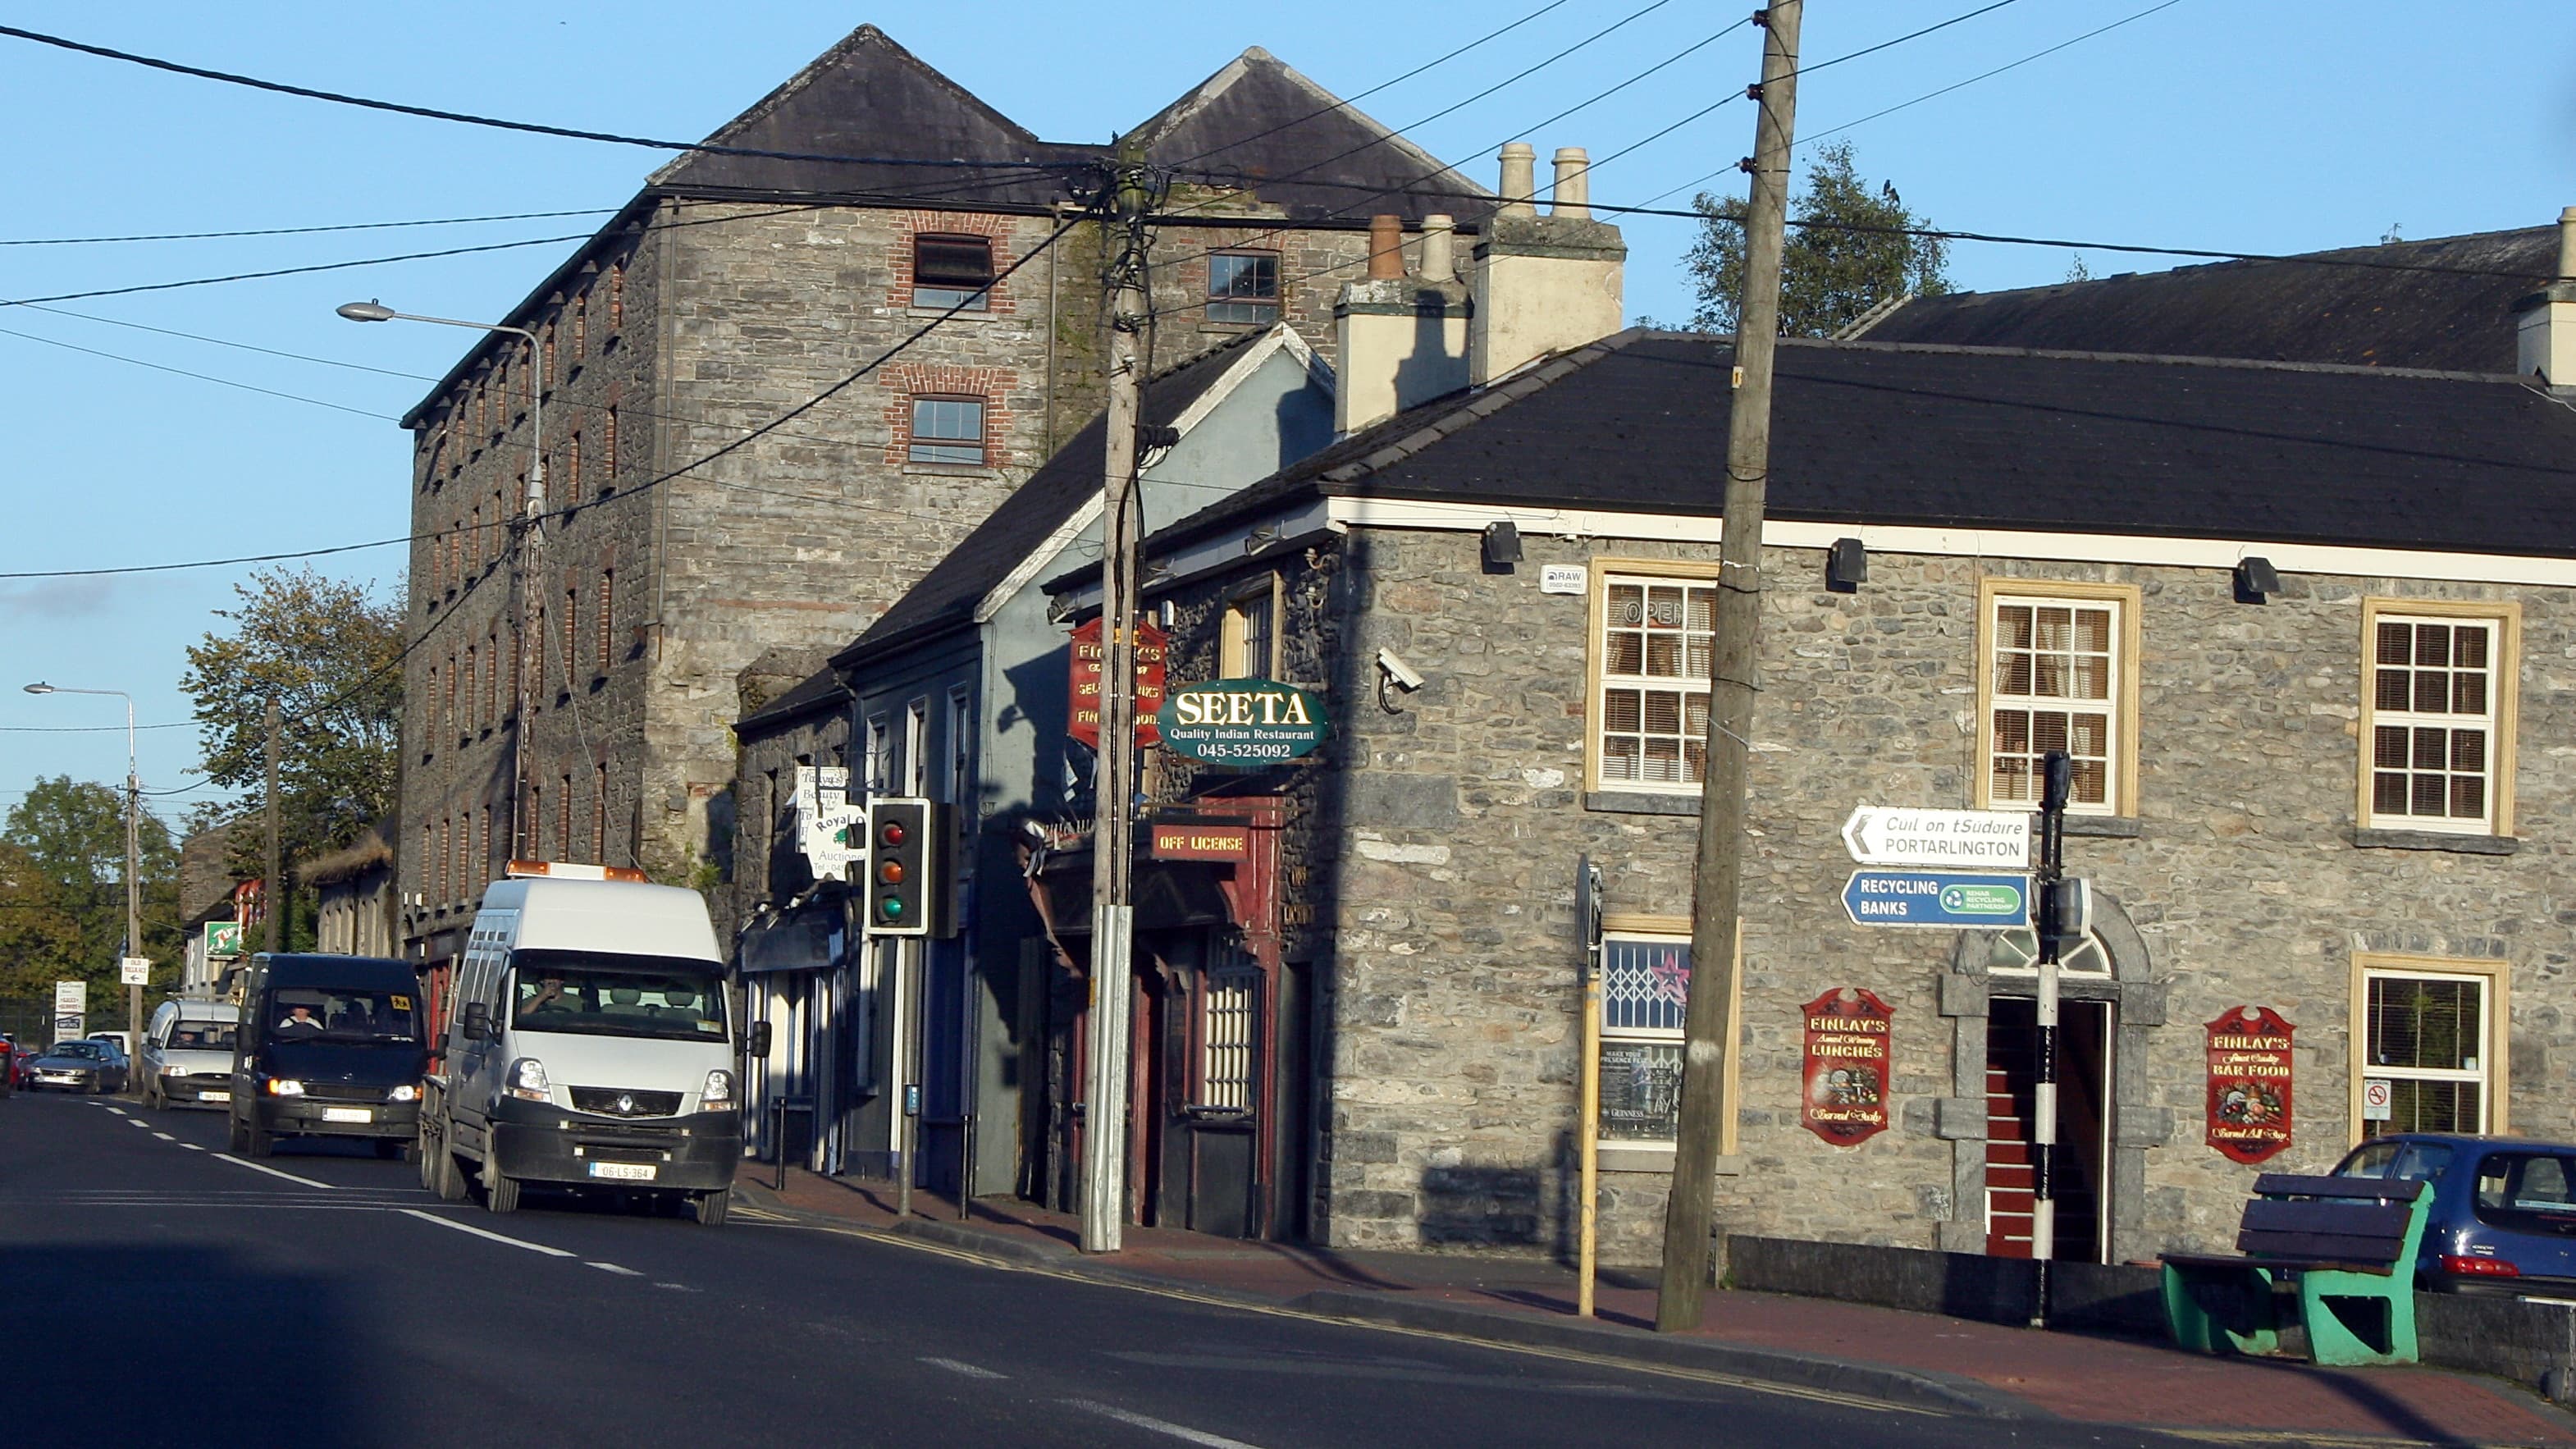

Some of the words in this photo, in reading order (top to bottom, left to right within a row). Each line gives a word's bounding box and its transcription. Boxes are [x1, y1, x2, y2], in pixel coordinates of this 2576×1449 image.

[1176, 692, 1313, 726] SEETA
[1170, 728, 1211, 741] Quality
[1215, 728, 1250, 739] Indian
[1254, 729, 1314, 740] Restaurant
[1196, 743, 1290, 757] 045-525092
[815, 813, 851, 833] Royal
[1159, 835, 1185, 850] OFF
[1190, 835, 1243, 852] LICENSE
[1885, 838, 2020, 857] PORTARLINGTON
[1861, 879, 1938, 895] RECYCLING
[1861, 900, 1907, 916] BANKS
[1811, 1017, 1886, 1032] FINLAY'S
[2213, 1036, 2288, 1050] FINLAY'S
[1811, 1044, 1883, 1058] LUNCHES
[2213, 1065, 2244, 1076] BAR
[2248, 1065, 2290, 1076] FOOD
